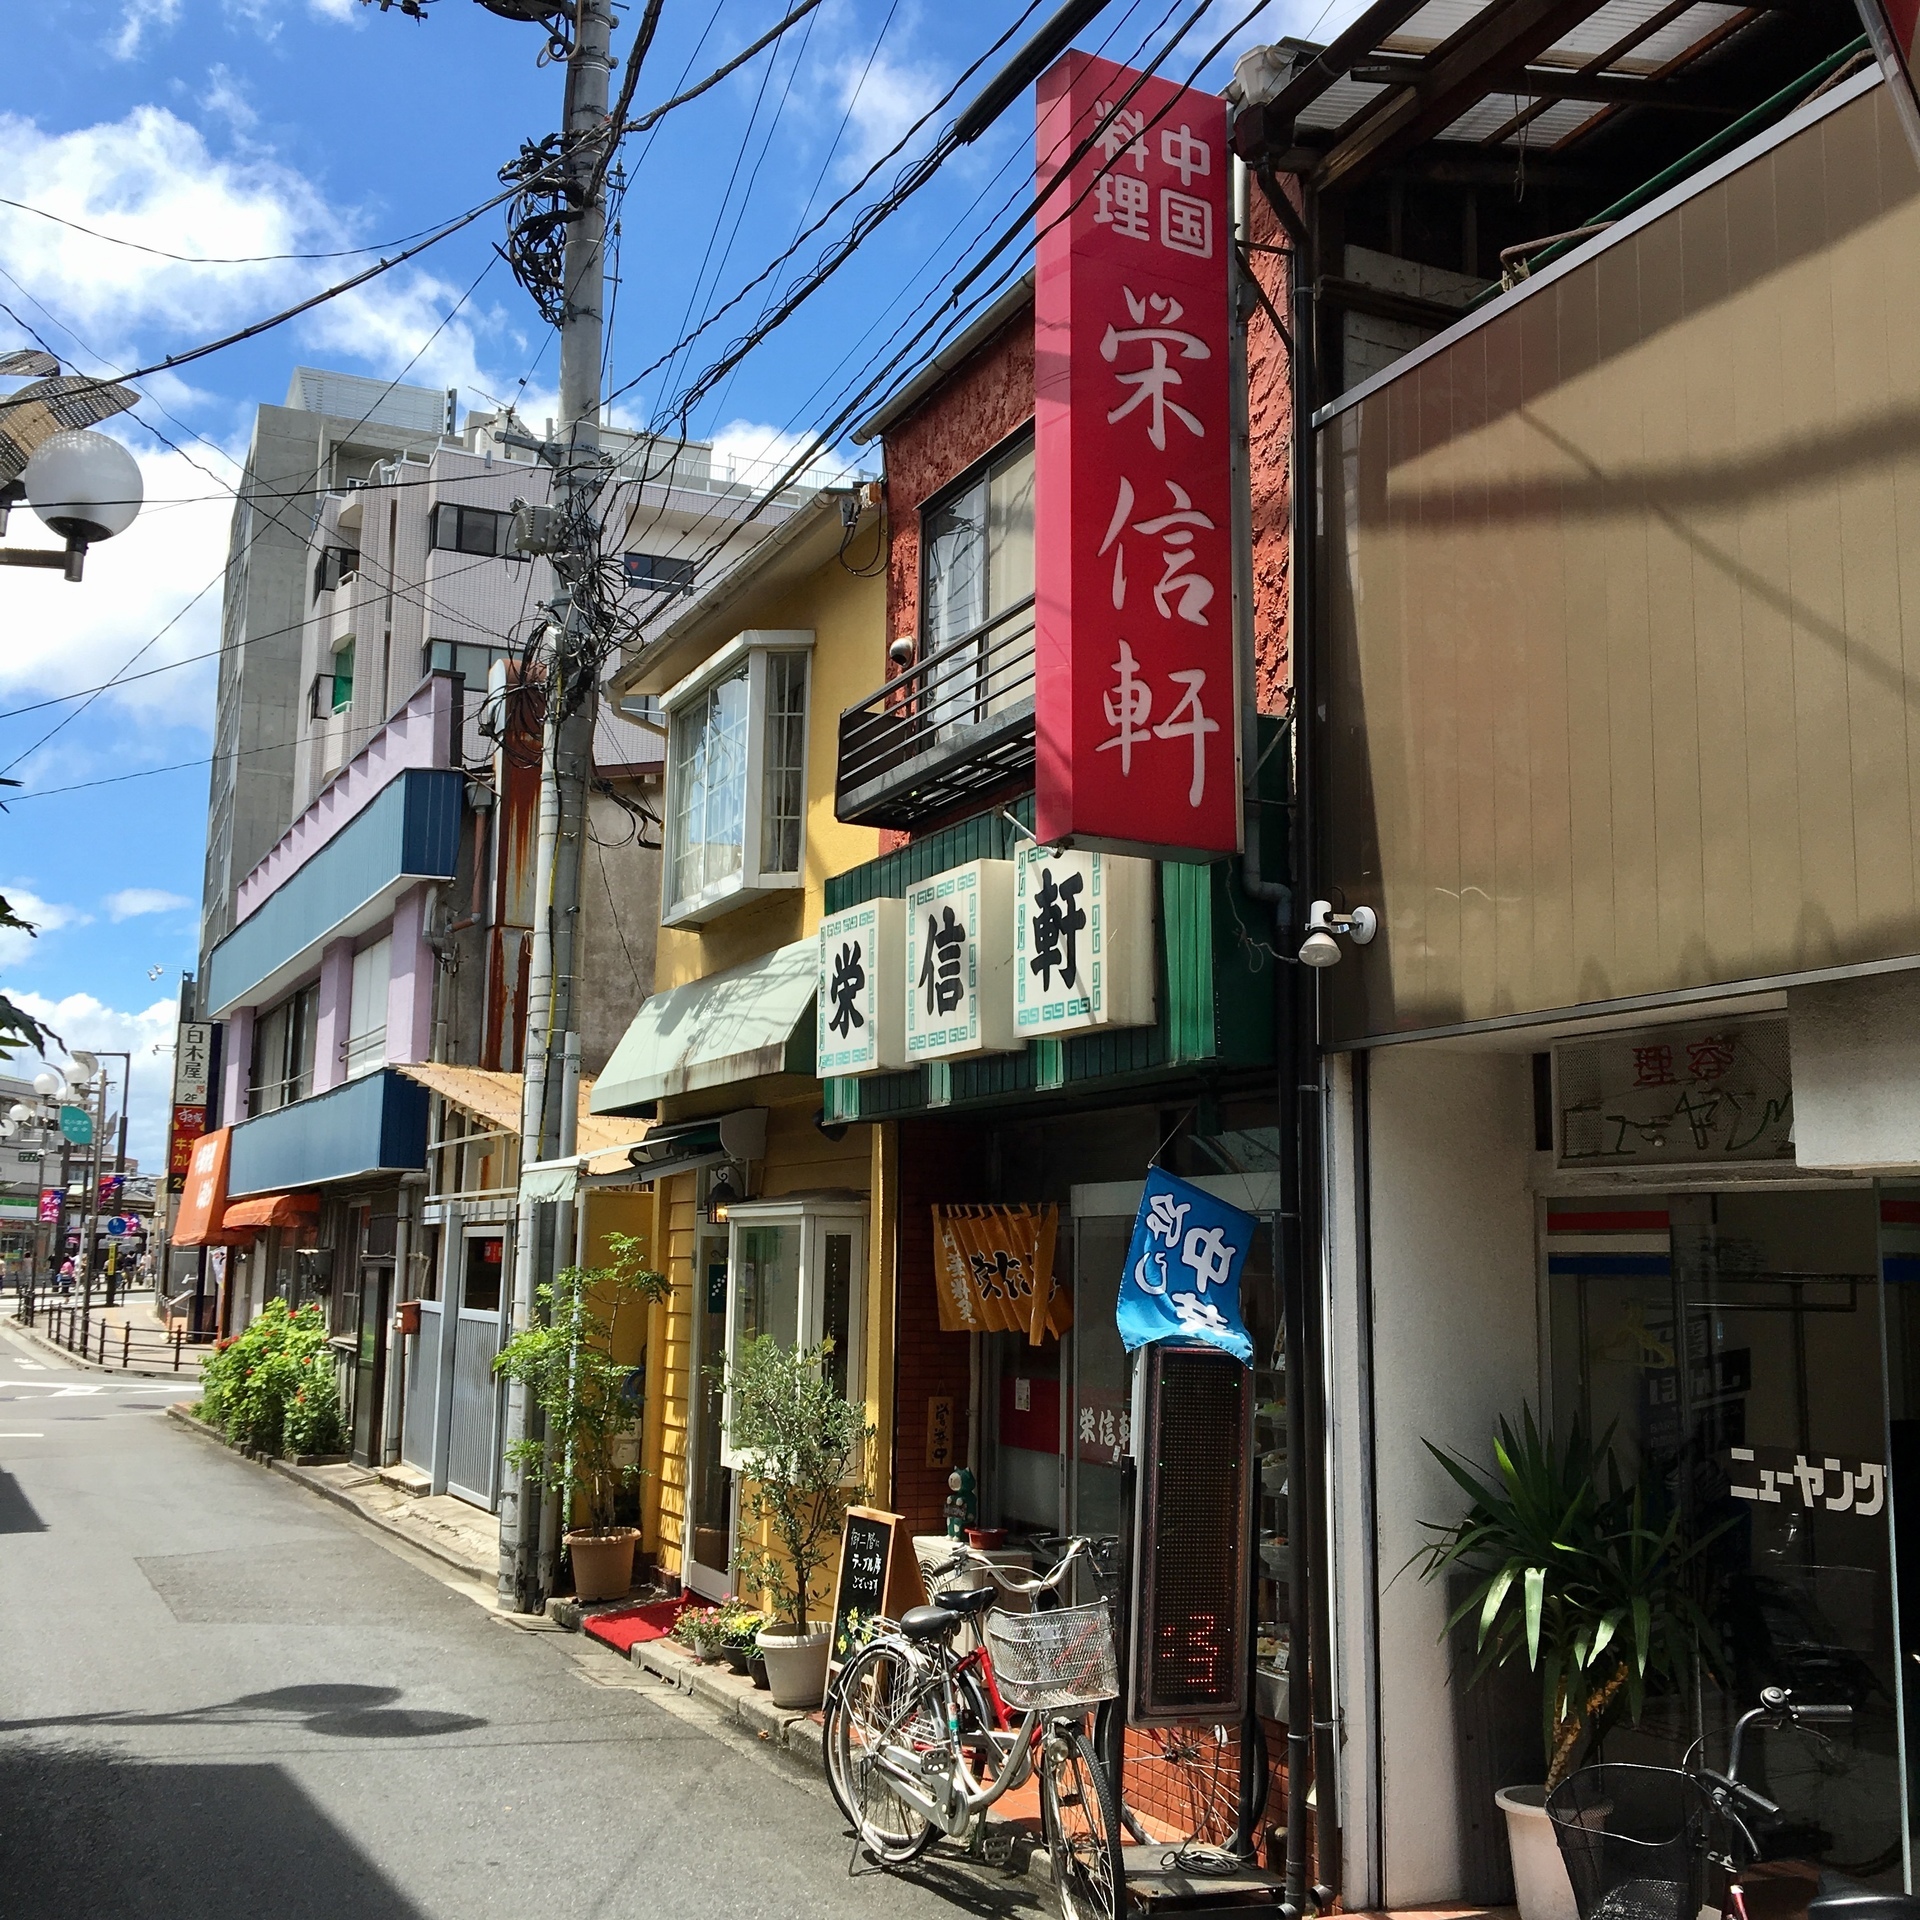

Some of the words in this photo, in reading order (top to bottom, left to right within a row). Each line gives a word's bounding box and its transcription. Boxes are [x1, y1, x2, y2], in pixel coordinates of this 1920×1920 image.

[1094, 100, 1150, 241] 料理
[1160, 124, 1213, 258] 中国
[1096, 285, 1219, 808] 栄信軒
[829, 868, 1087, 1039] 栄信軒
[183, 1025, 204, 1078] 白木屋
[1632, 1036, 1736, 1088] 理容
[177, 1108, 203, 1125] すき家
[184, 1093, 197, 1102] 2F
[1731, 1447, 1887, 1516] ニューヤング
